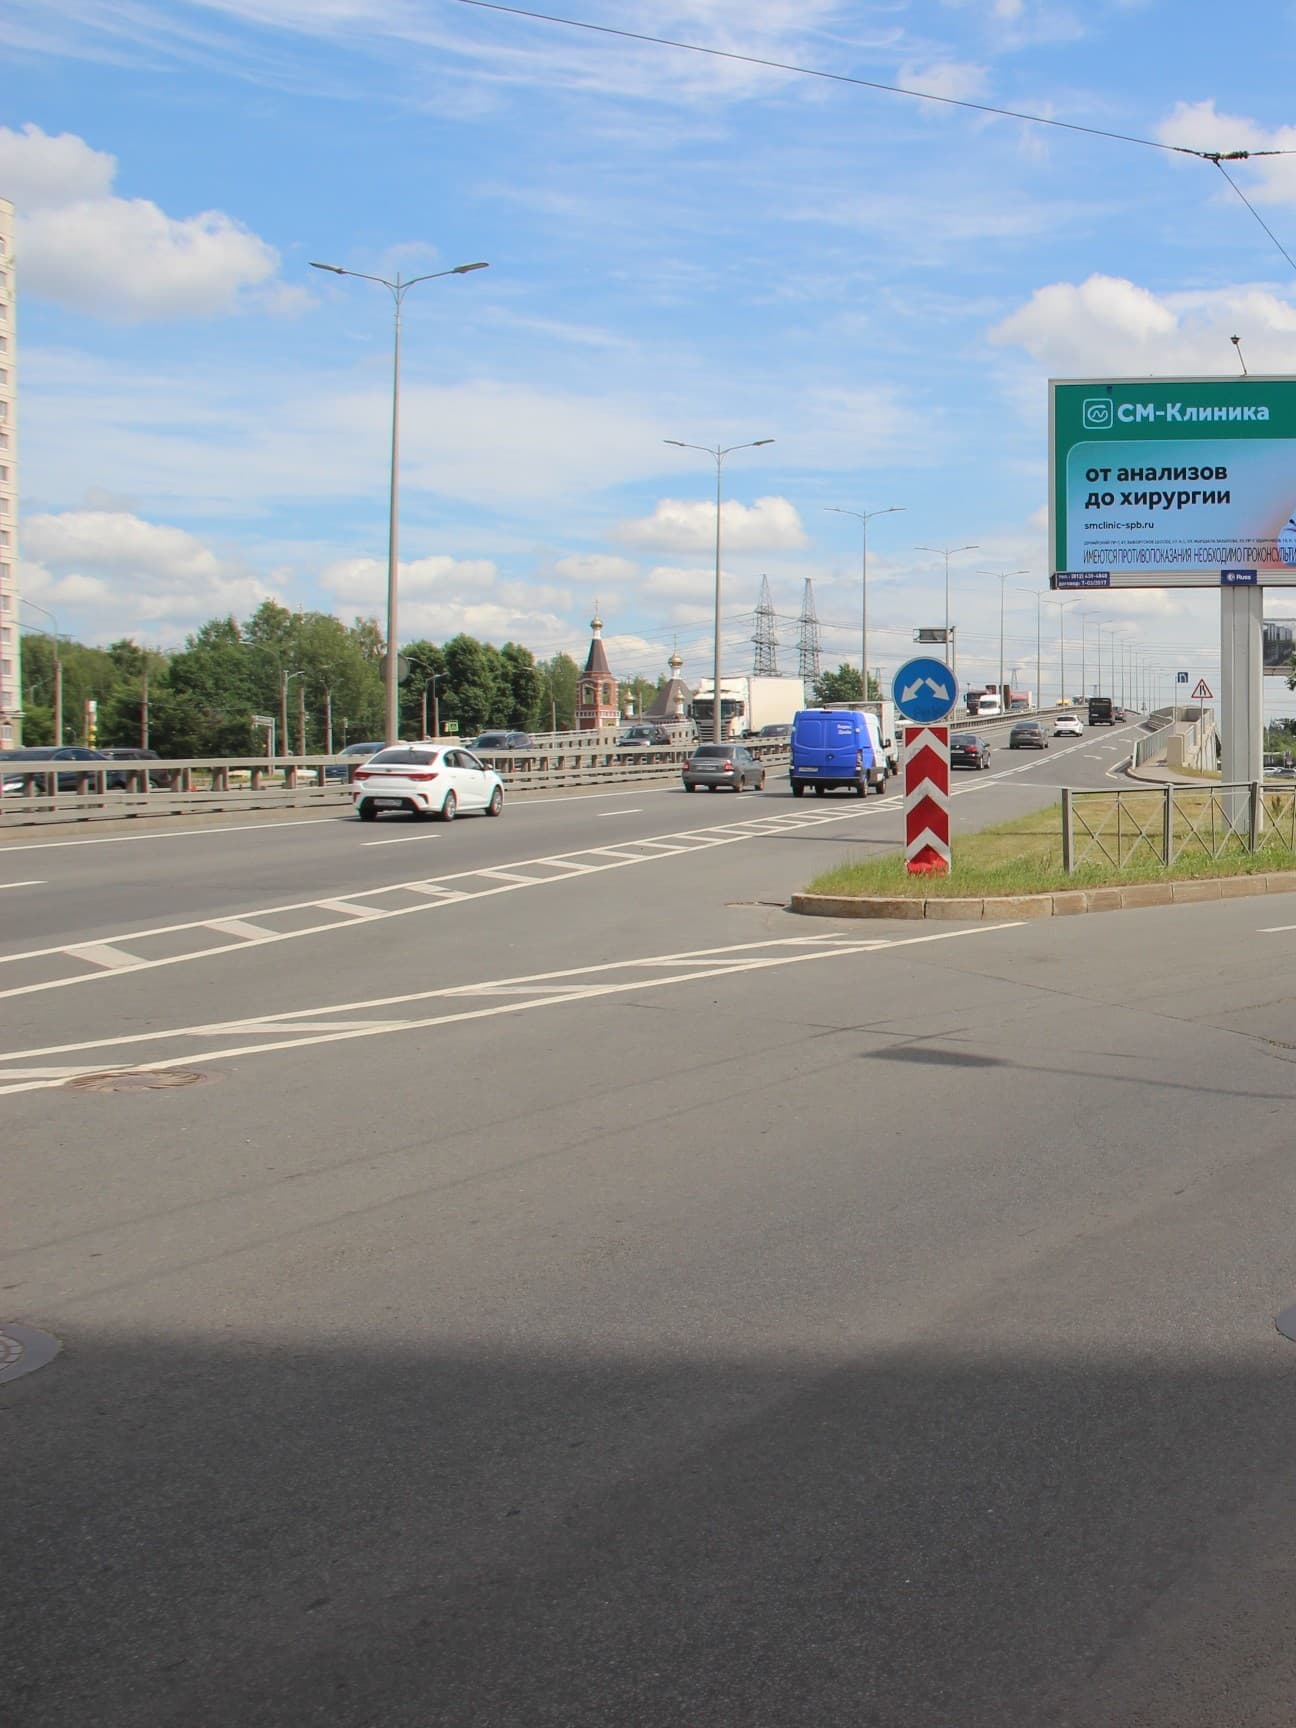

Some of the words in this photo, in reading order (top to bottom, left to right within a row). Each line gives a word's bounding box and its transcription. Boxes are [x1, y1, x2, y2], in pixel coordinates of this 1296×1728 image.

[1117, 403, 1270, 422] СМ-Клиника
[1085, 467, 1112, 482] от
[1117, 466, 1228, 482] анализов
[1085, 492, 1115, 509] до
[1119, 490, 1231, 510] хирургии
[1084, 520, 1155, 531] smclinic-spb.ru
[1083, 548, 1117, 564] ИМЕЮТСЯ
[1118, 547, 1192, 564] ПРОТИВОПОКАЗАНИЯ
[1194, 547, 1242, 565] НЕОБХОДИМО
